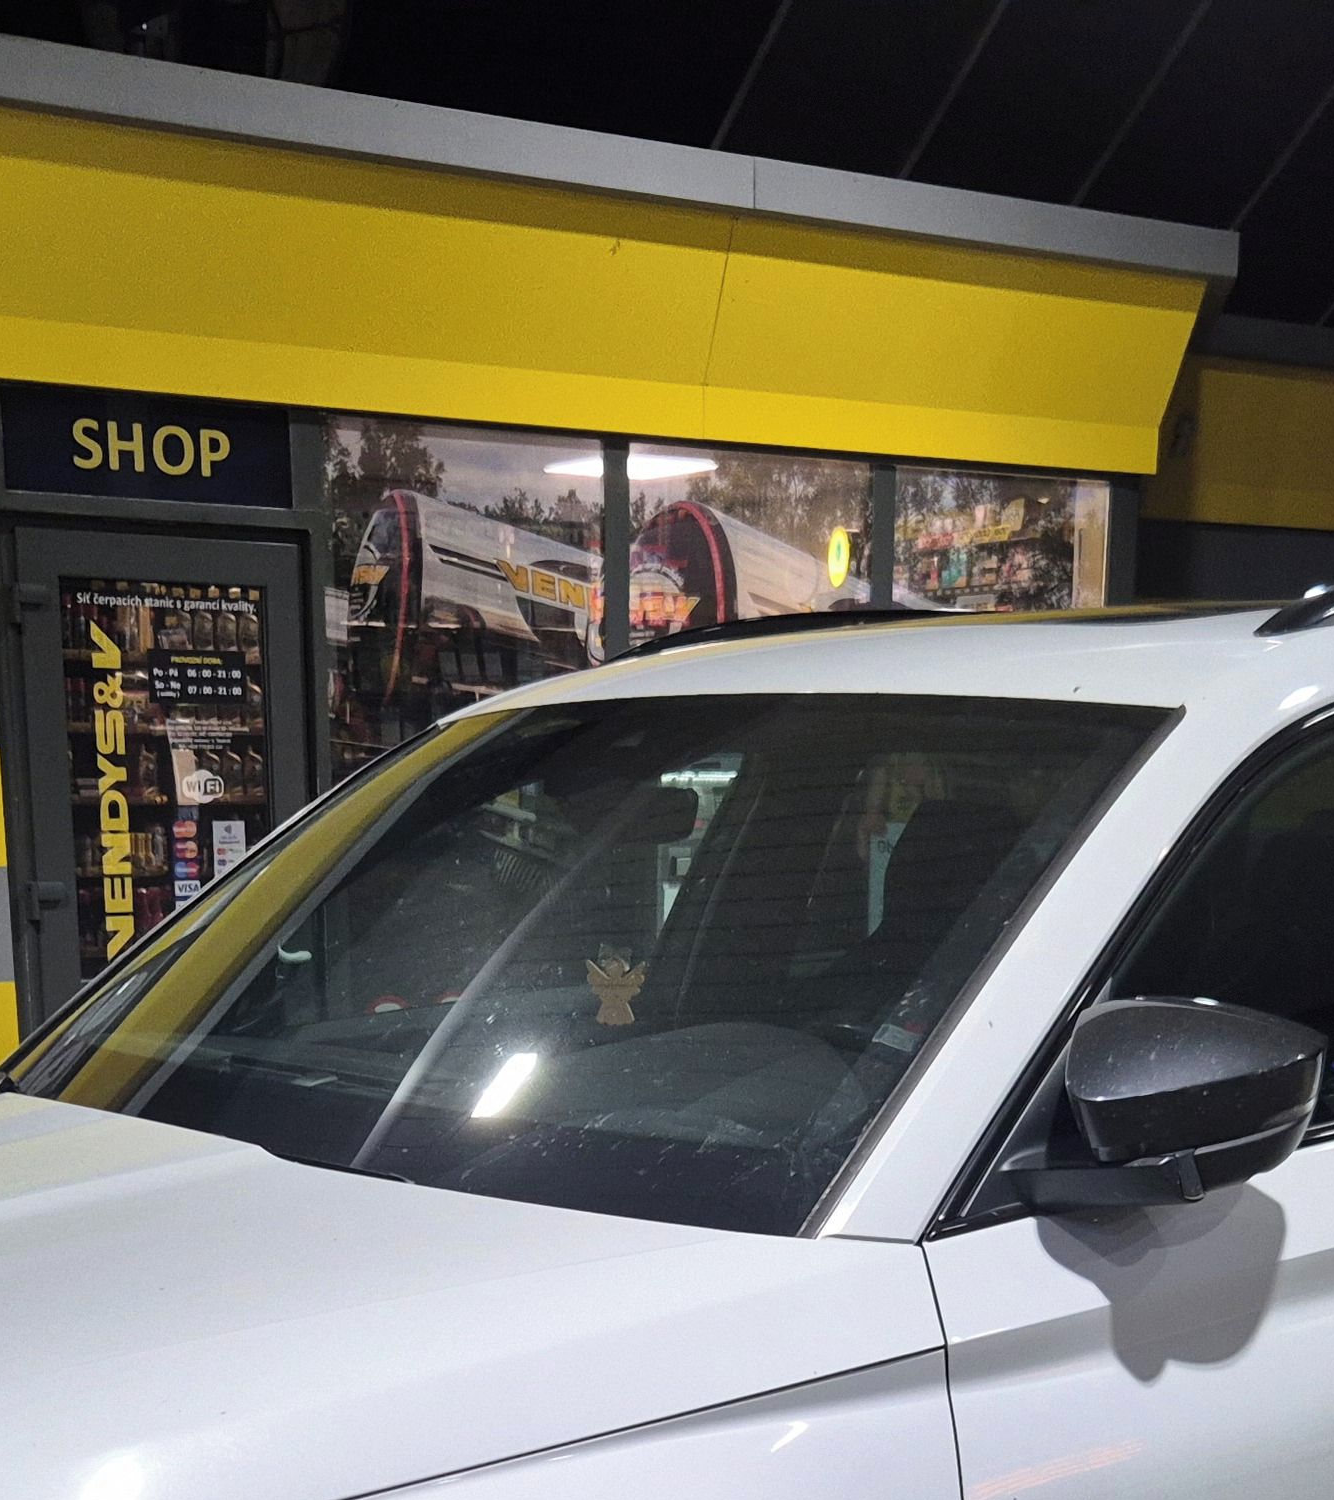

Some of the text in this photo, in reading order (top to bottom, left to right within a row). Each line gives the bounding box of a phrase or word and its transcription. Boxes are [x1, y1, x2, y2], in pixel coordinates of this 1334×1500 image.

[72, 418, 230, 477] SHOP
[93, 593, 142, 607] čerpacích
[144, 597, 174, 608] stanic
[183, 599, 220, 611] garancí
[221, 600, 257, 614] kvality.
[495, 557, 589, 612] VEN
[152, 668, 163, 677] Po
[90, 620, 135, 963] VENDYS&V
[178, 883, 200, 893] VISA
